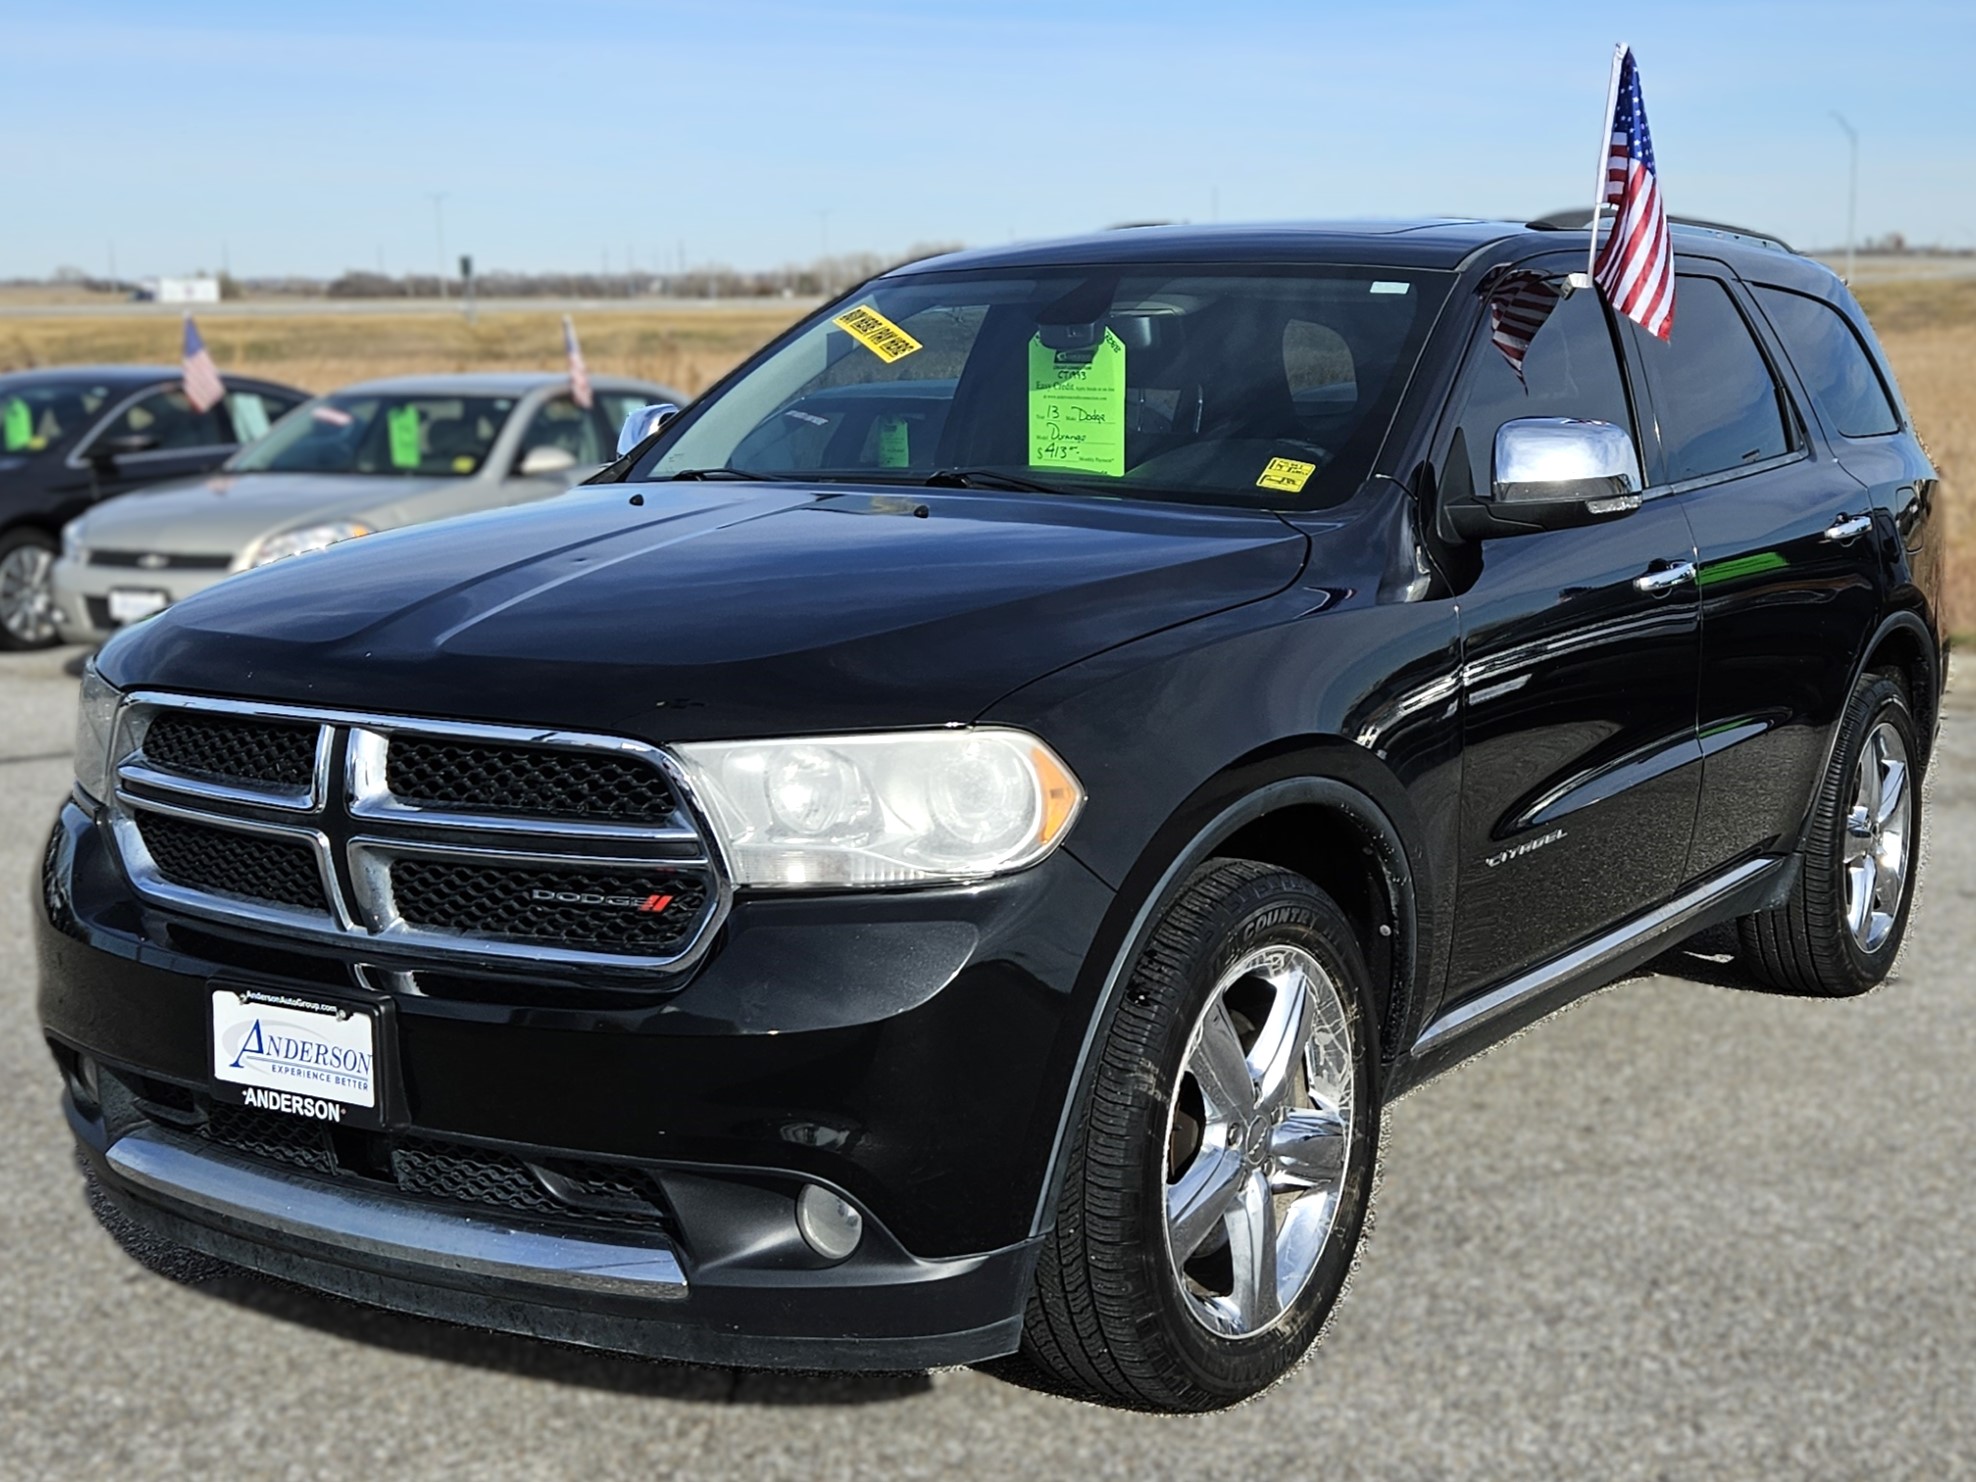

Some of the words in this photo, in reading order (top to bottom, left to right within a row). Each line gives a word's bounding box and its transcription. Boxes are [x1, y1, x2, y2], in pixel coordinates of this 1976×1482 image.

[1047, 405, 1060, 418] 13
[1071, 406, 1105, 424] Dodge
[1485, 829, 1568, 867] CITADEL
[532, 889, 651, 907] DODGE
[1243, 907, 1319, 942] COUNTRY
[246, 990, 337, 1012] AndersonAutoGroup.com
[229, 1019, 373, 1075] ANDERSON
[271, 1064, 331, 1083] EXPERIENCE
[334, 1072, 369, 1091] BETTER
[244, 1088, 340, 1122] ANDERSON
